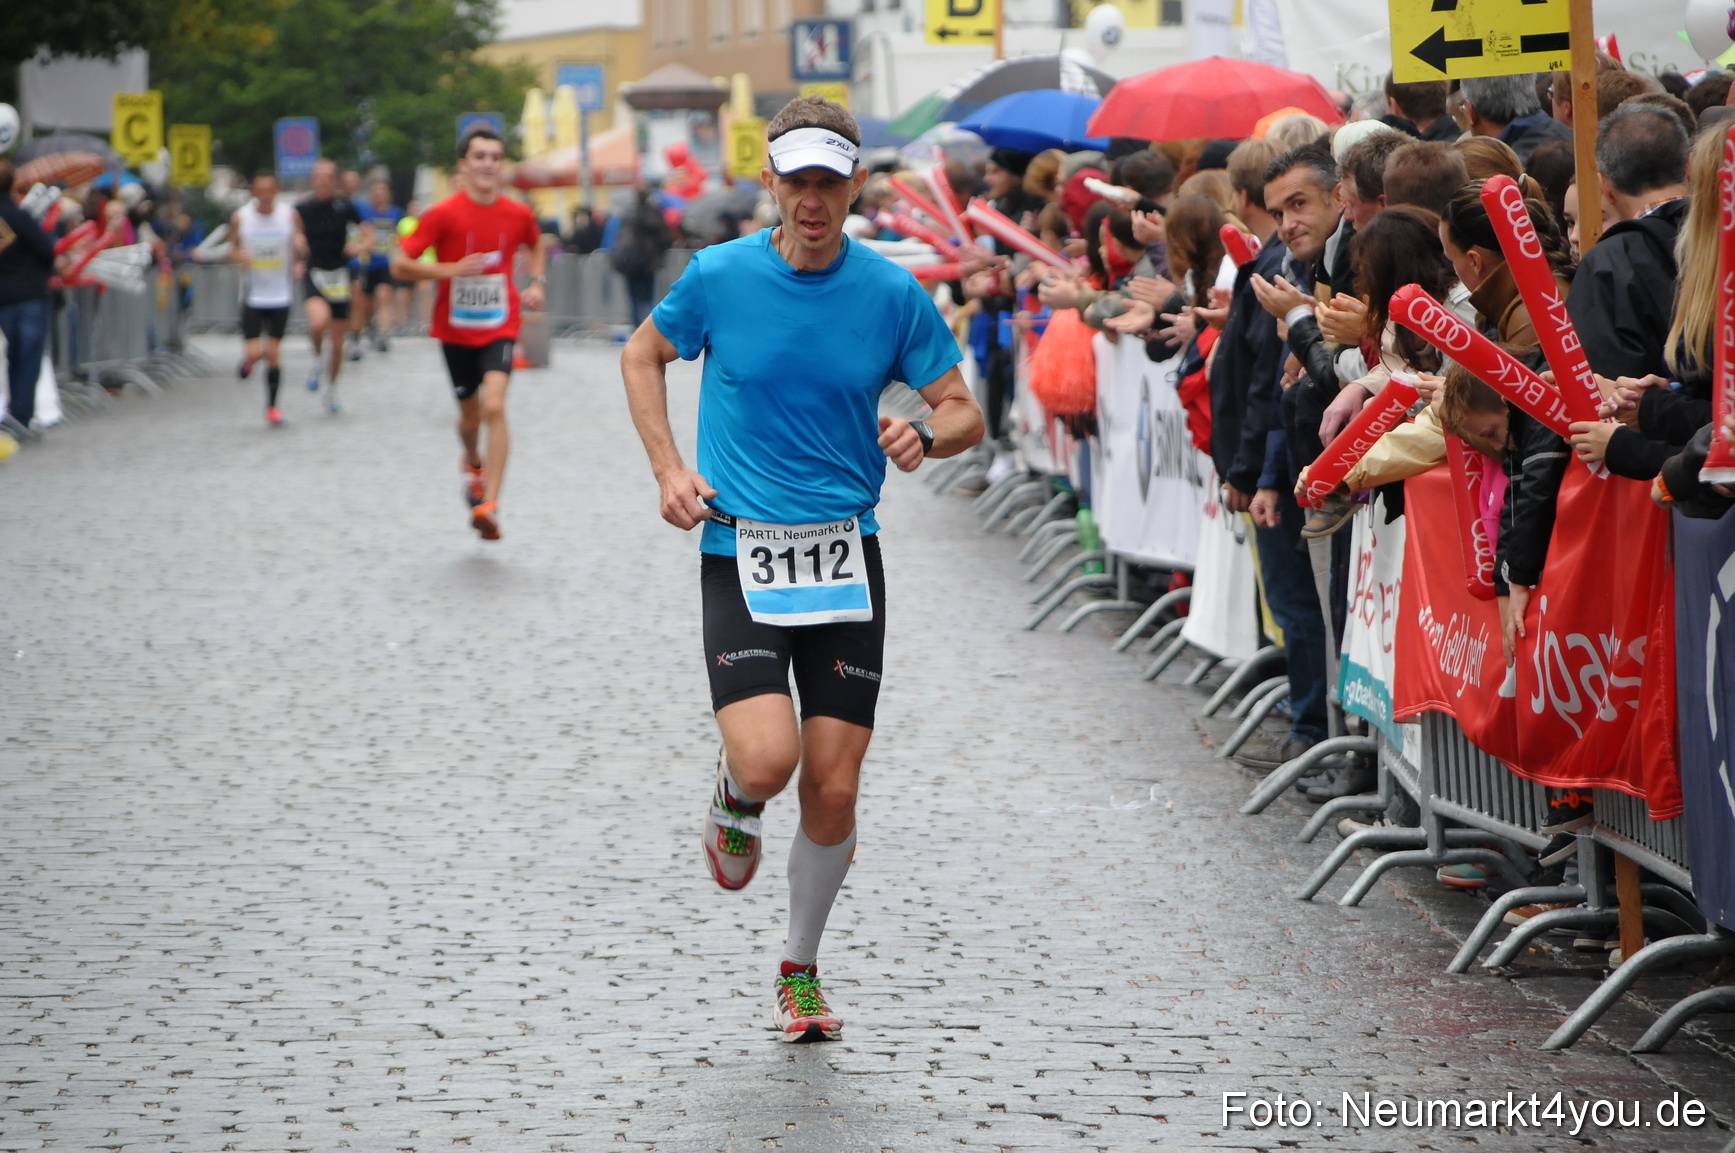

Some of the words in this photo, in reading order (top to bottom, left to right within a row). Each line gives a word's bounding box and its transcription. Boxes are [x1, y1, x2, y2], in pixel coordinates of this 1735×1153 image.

[124, 112, 150, 148] C
[826, 138, 849, 151] 2XU
[457, 287, 500, 305] 2004
[1541, 286, 1581, 354] BKK
[1486, 354, 1546, 406] BKK
[1364, 398, 1407, 437] Audi
[1333, 437, 1375, 469] BKK
[1461, 440, 1483, 491] KK
[740, 528, 780, 540] PARTL
[784, 524, 839, 540] Neumarkt
[750, 538, 853, 585] 3112
[1440, 612, 1470, 678] Geld
[1457, 622, 1489, 698] geht
